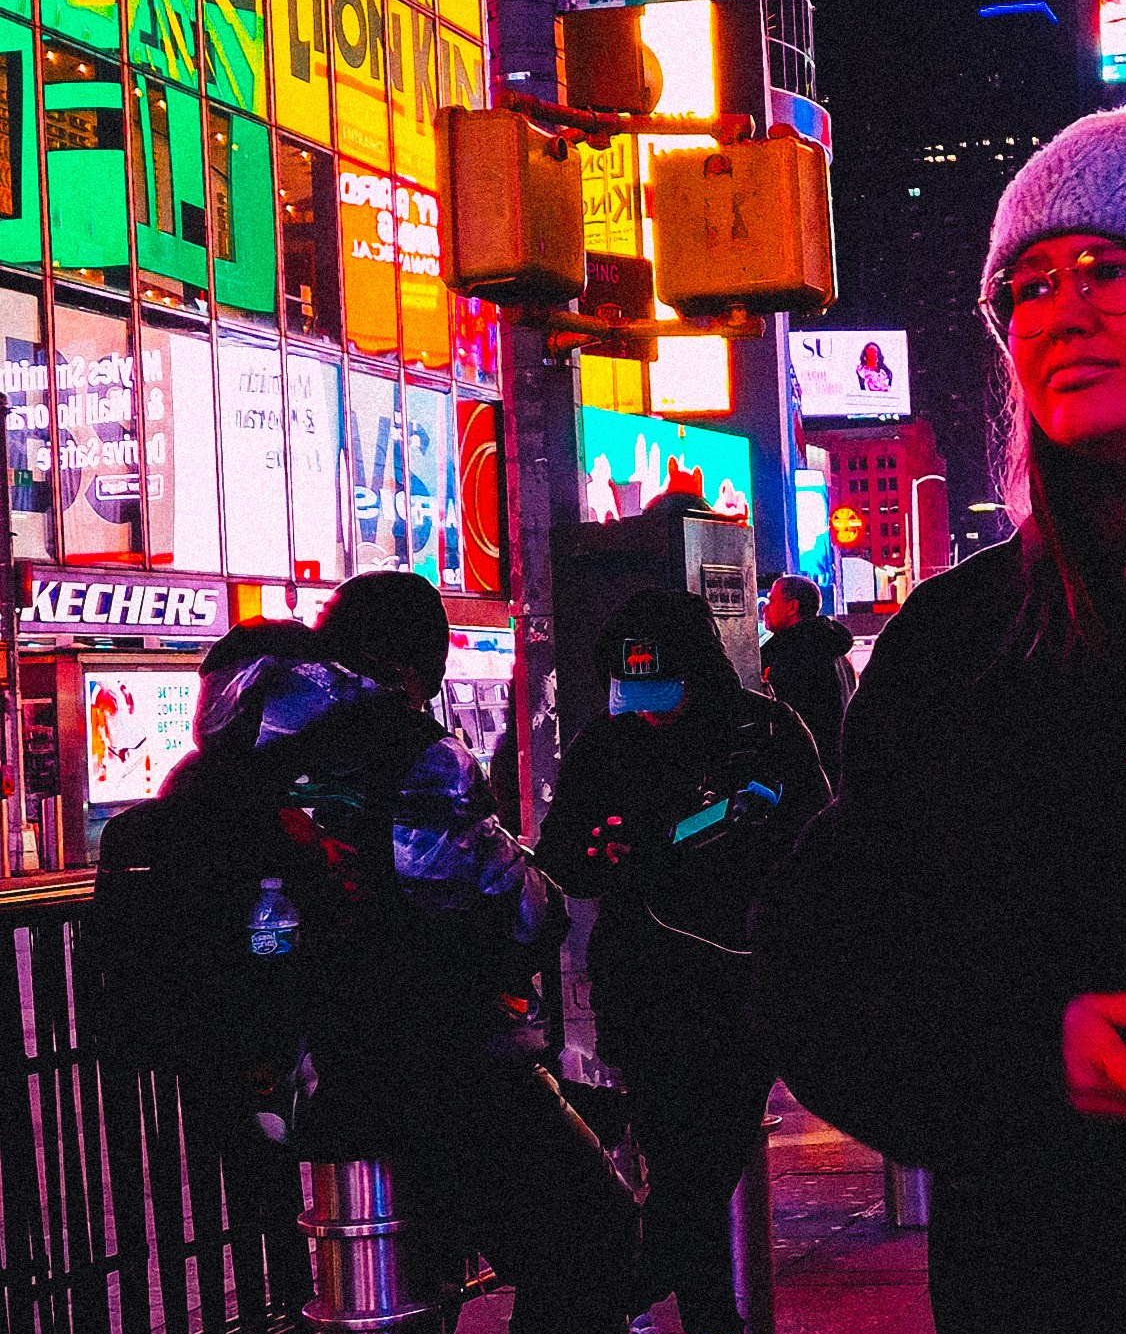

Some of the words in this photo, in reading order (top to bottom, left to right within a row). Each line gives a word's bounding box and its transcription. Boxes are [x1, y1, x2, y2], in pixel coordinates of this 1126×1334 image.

[586, 262, 619, 284] PING
[802, 338, 833, 359] SU
[20, 579, 220, 626] KECHERS
